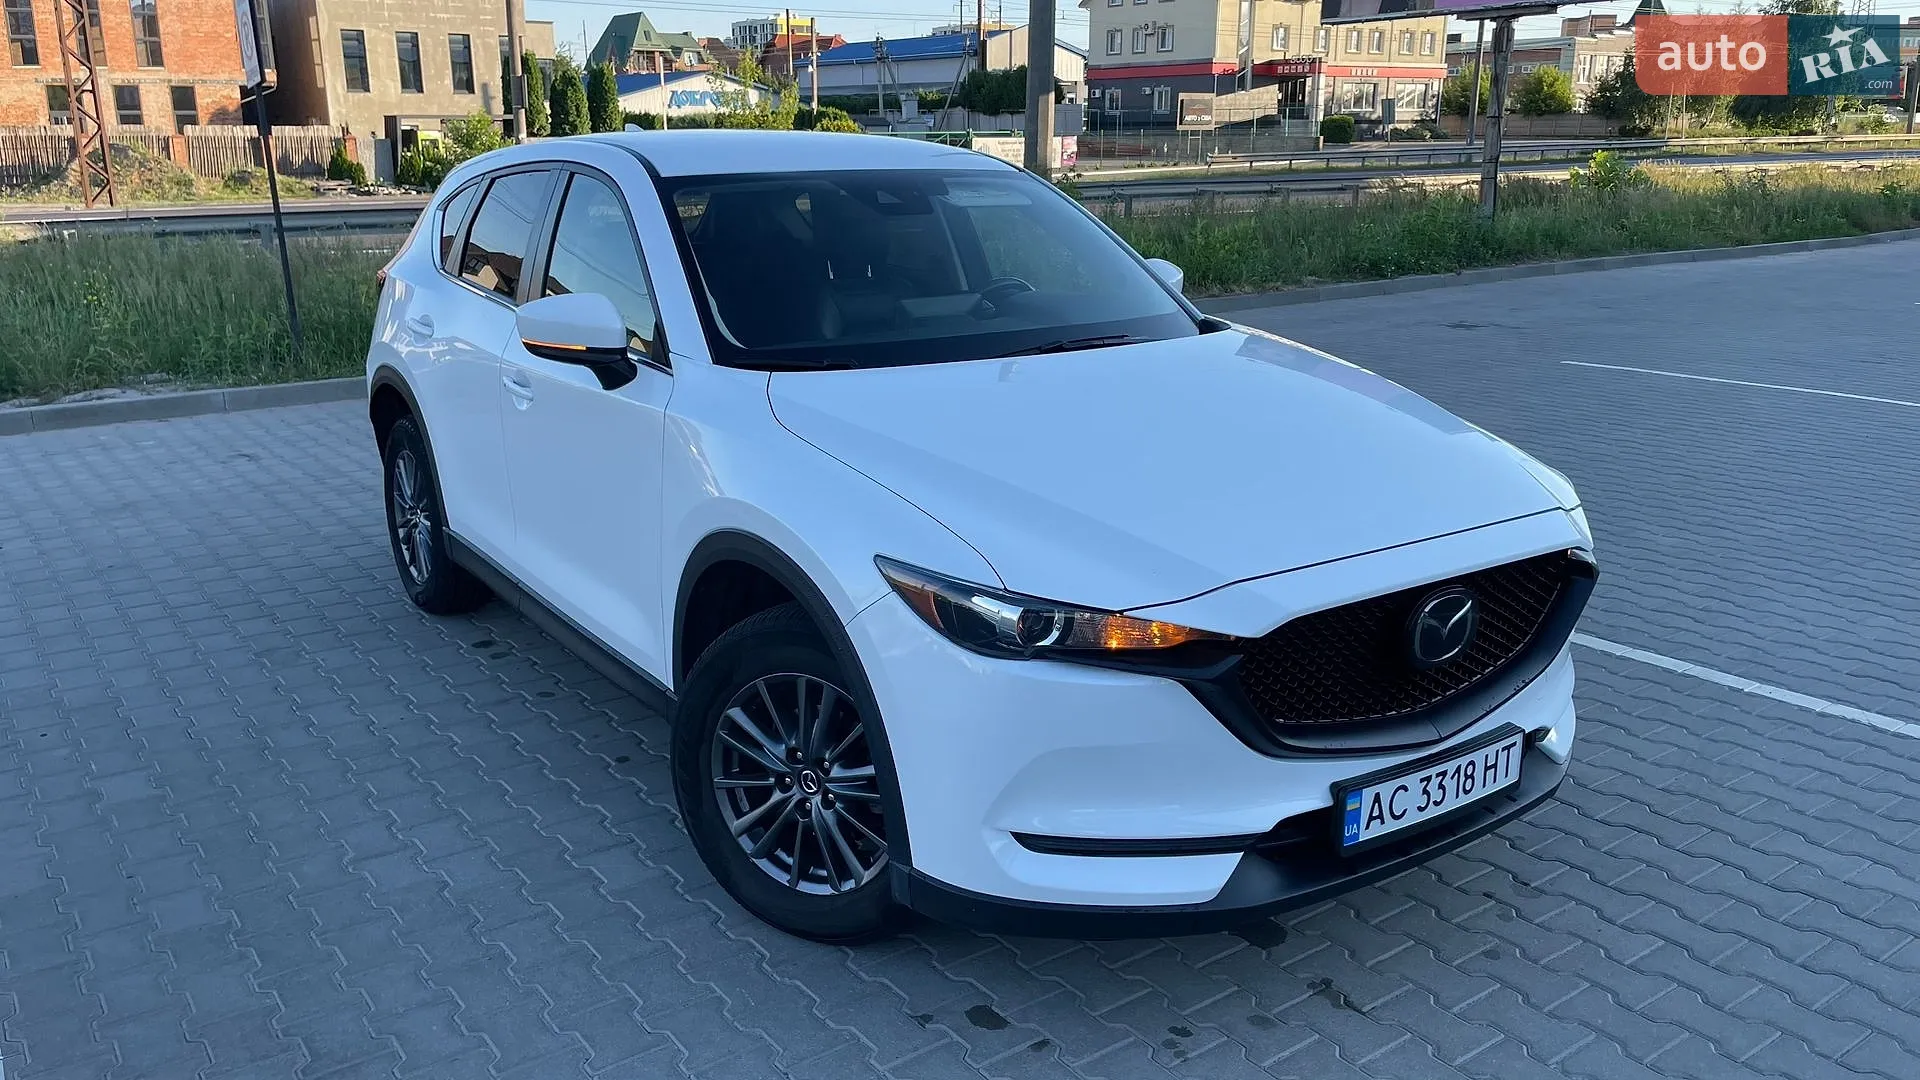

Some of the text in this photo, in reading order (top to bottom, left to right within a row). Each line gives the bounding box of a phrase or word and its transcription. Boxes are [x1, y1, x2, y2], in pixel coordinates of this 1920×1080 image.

[1364, 741, 1517, 831] AC 3318 HT
[1344, 823, 1359, 837] UA
